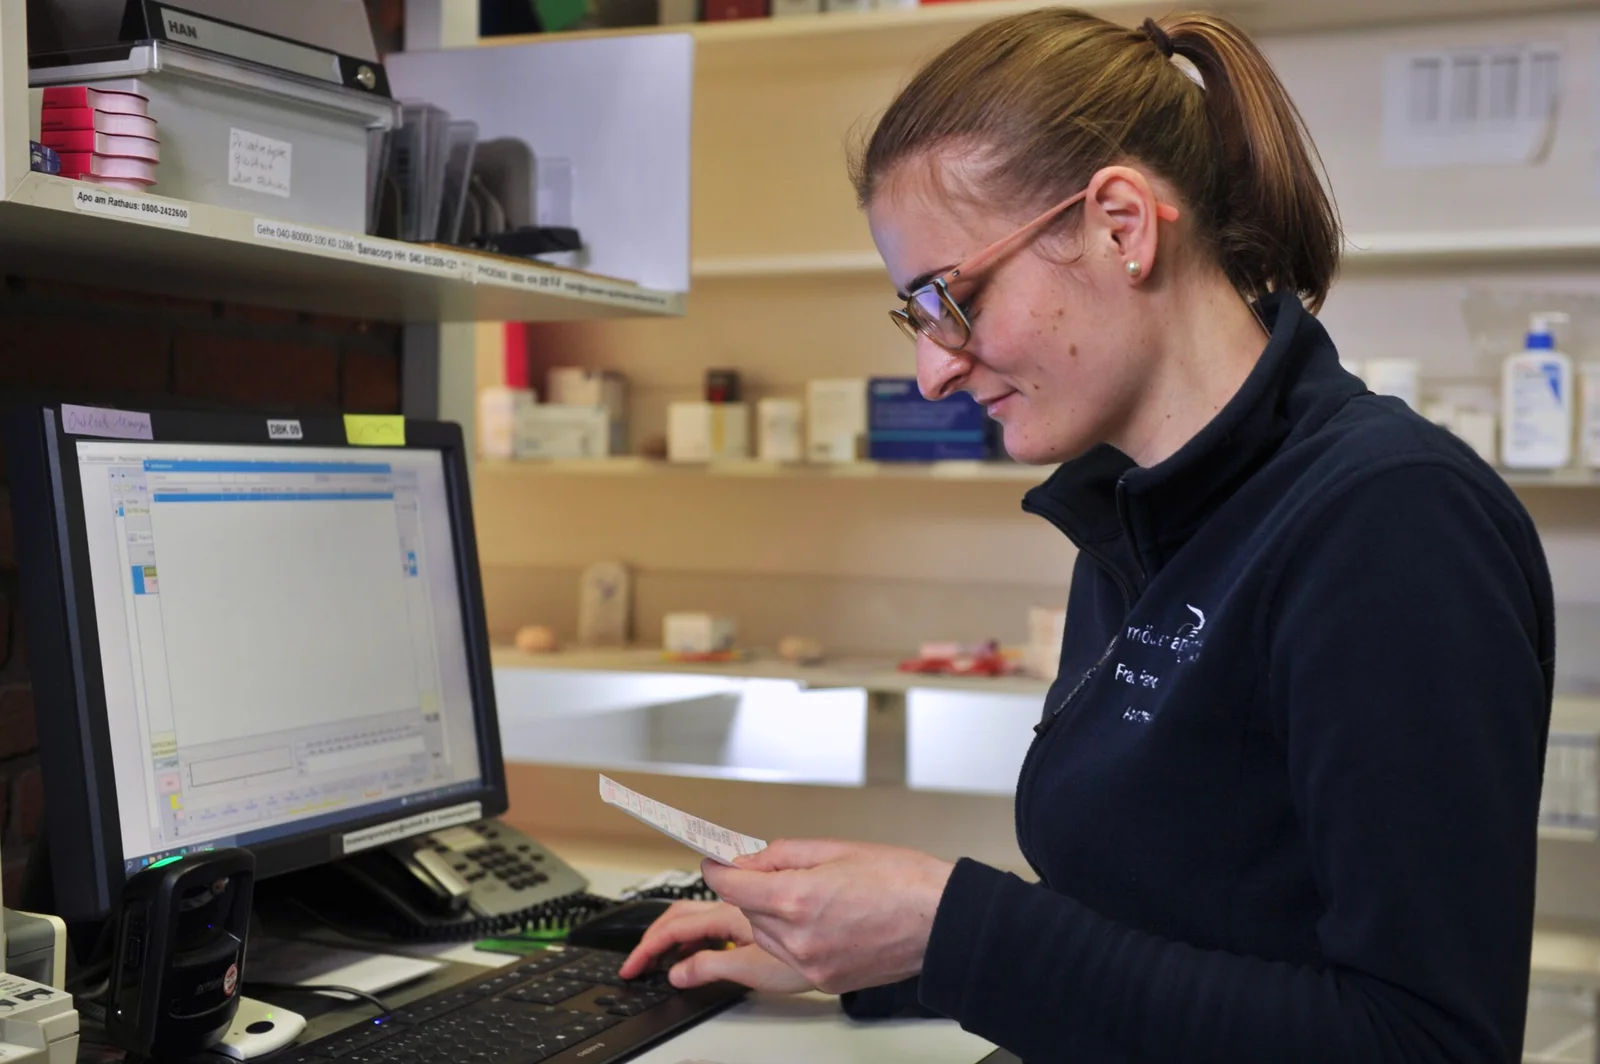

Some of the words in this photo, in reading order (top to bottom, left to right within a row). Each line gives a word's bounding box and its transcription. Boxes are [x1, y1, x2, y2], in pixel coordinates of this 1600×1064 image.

[168, 20, 197, 39] HAN
[77, 191, 93, 203] Apo
[94, 196, 106, 205] am
[107, 196, 140, 210] Rathaus:
[141, 203, 188, 219] 0800-2422600
[257, 224, 275, 236] Gehe
[270, 423, 288, 436] DBK
